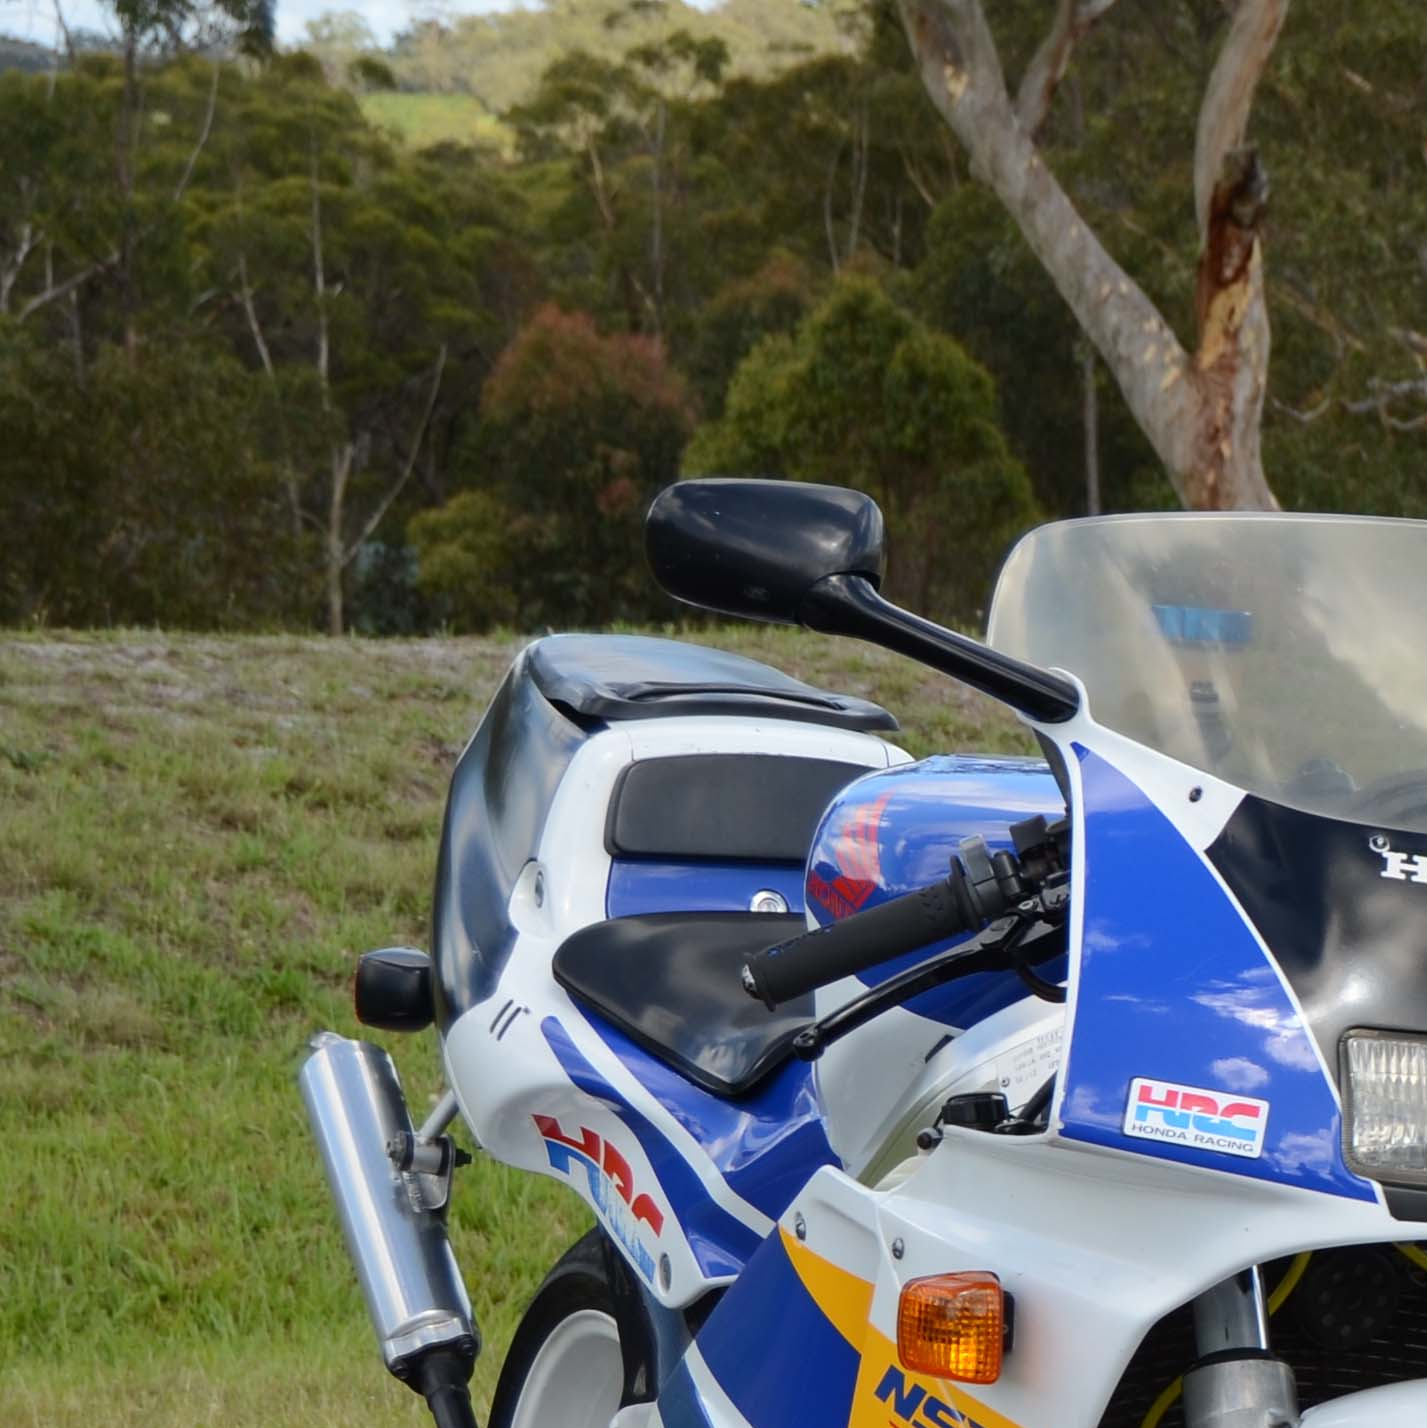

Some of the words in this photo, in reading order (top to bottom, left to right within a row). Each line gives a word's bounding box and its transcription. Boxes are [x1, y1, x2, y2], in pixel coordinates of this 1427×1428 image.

[1134, 1084, 1261, 1142] HRC
[1131, 1123, 1187, 1140] HONDA
[1193, 1134, 1254, 1152] RACING
